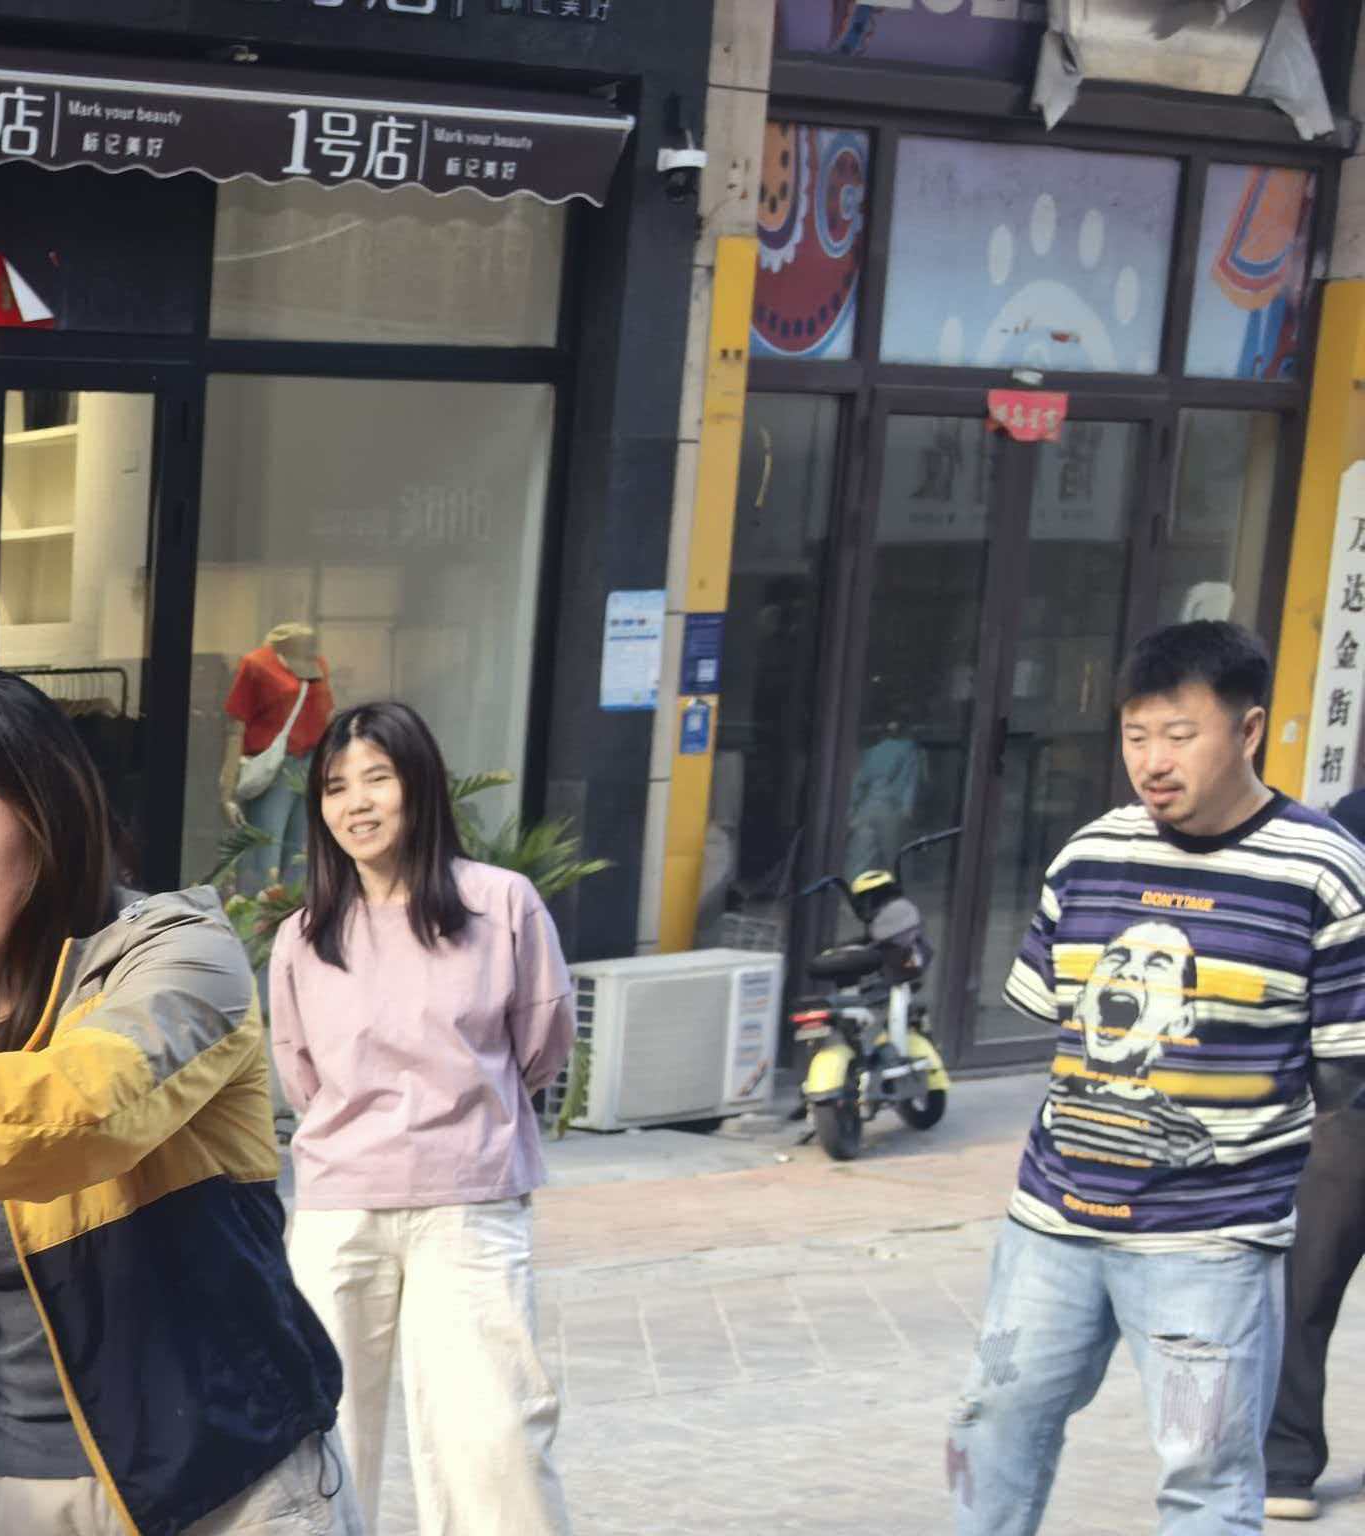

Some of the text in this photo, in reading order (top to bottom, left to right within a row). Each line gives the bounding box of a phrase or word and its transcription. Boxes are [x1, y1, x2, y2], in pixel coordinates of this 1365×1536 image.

[69, 100, 182, 126] Mark your beauty
[82, 131, 165, 158] 标记美好
[282, 108, 417, 180] 1号店
